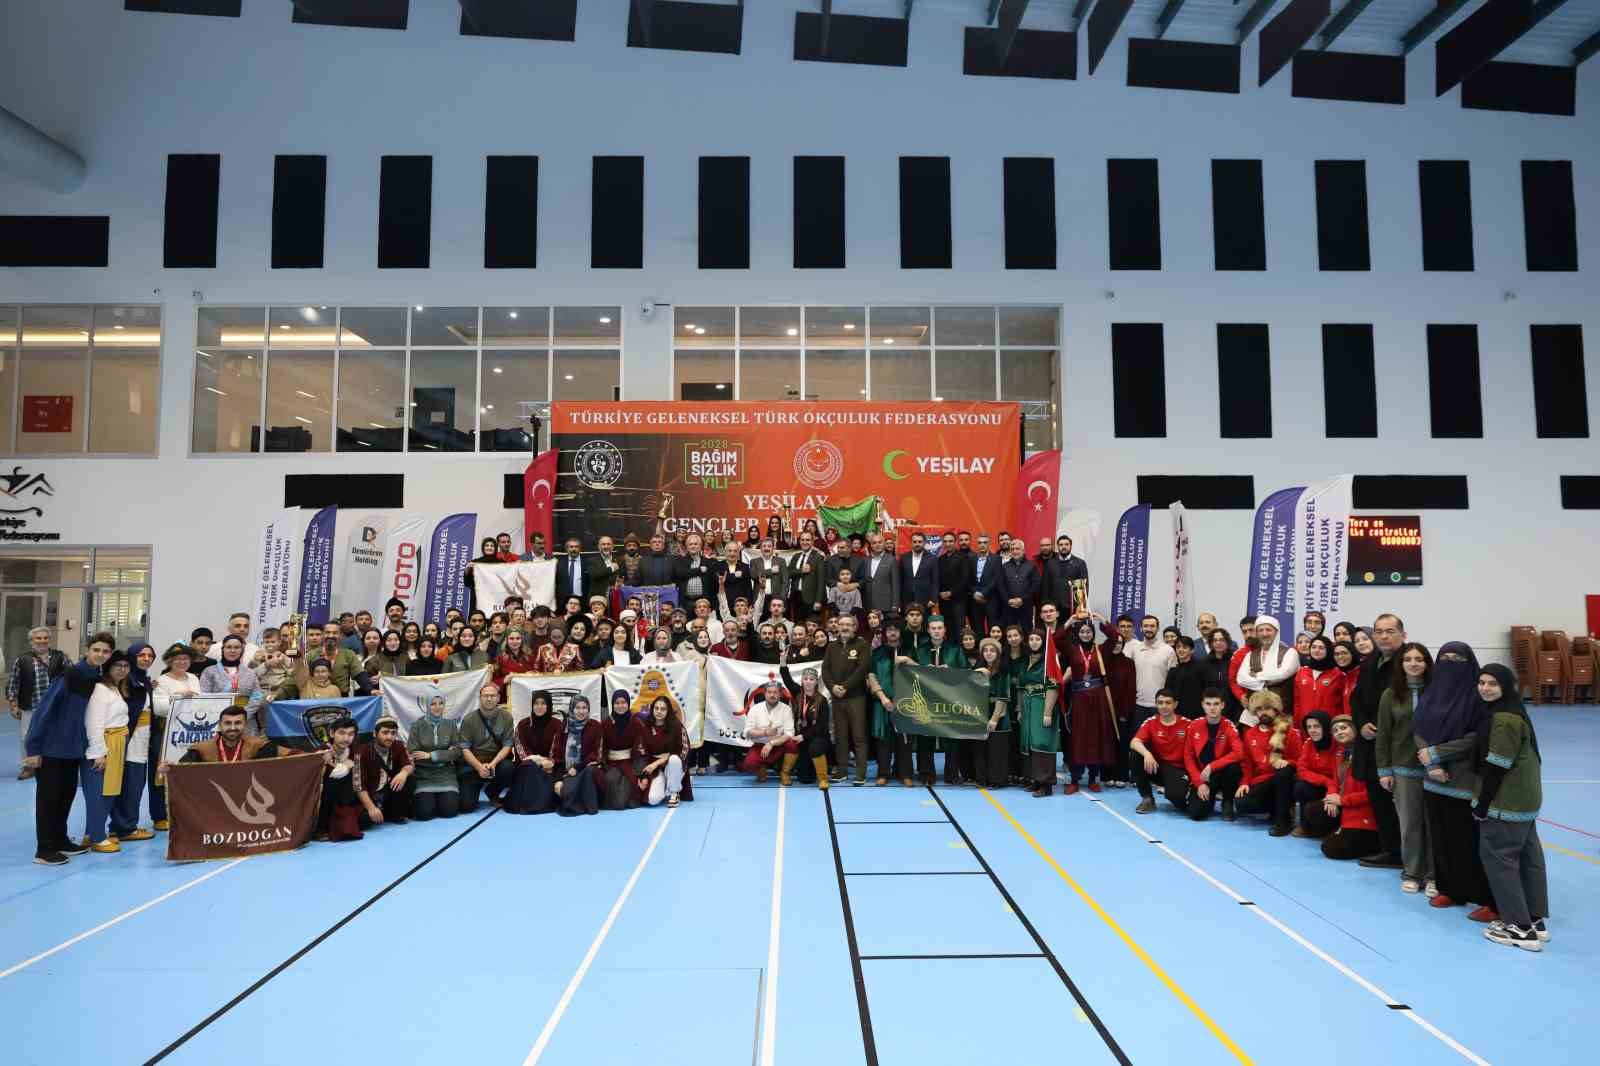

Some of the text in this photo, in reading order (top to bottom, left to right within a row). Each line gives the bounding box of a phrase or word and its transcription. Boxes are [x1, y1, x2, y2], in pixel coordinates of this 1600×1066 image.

[570, 410, 1002, 427] TÜRKİYE GELENEKSEL TÜRK OKÇULUK FEDERASYONU
[691, 449, 737, 464] BAĞIM
[691, 463, 737, 476] SIZLIK
[916, 457, 995, 477] YEŞİLAY
[702, 477, 728, 489] YILI
[1305, 498, 1316, 578] GELENEKSEL
[1320, 517, 1331, 578] OKÇULUK
[1257, 506, 1275, 617] RKİYE GELENEKSEL
[1270, 524, 1287, 615] TÜRK OKÇULUK
[432, 587, 443, 623] ÜRKİYE
